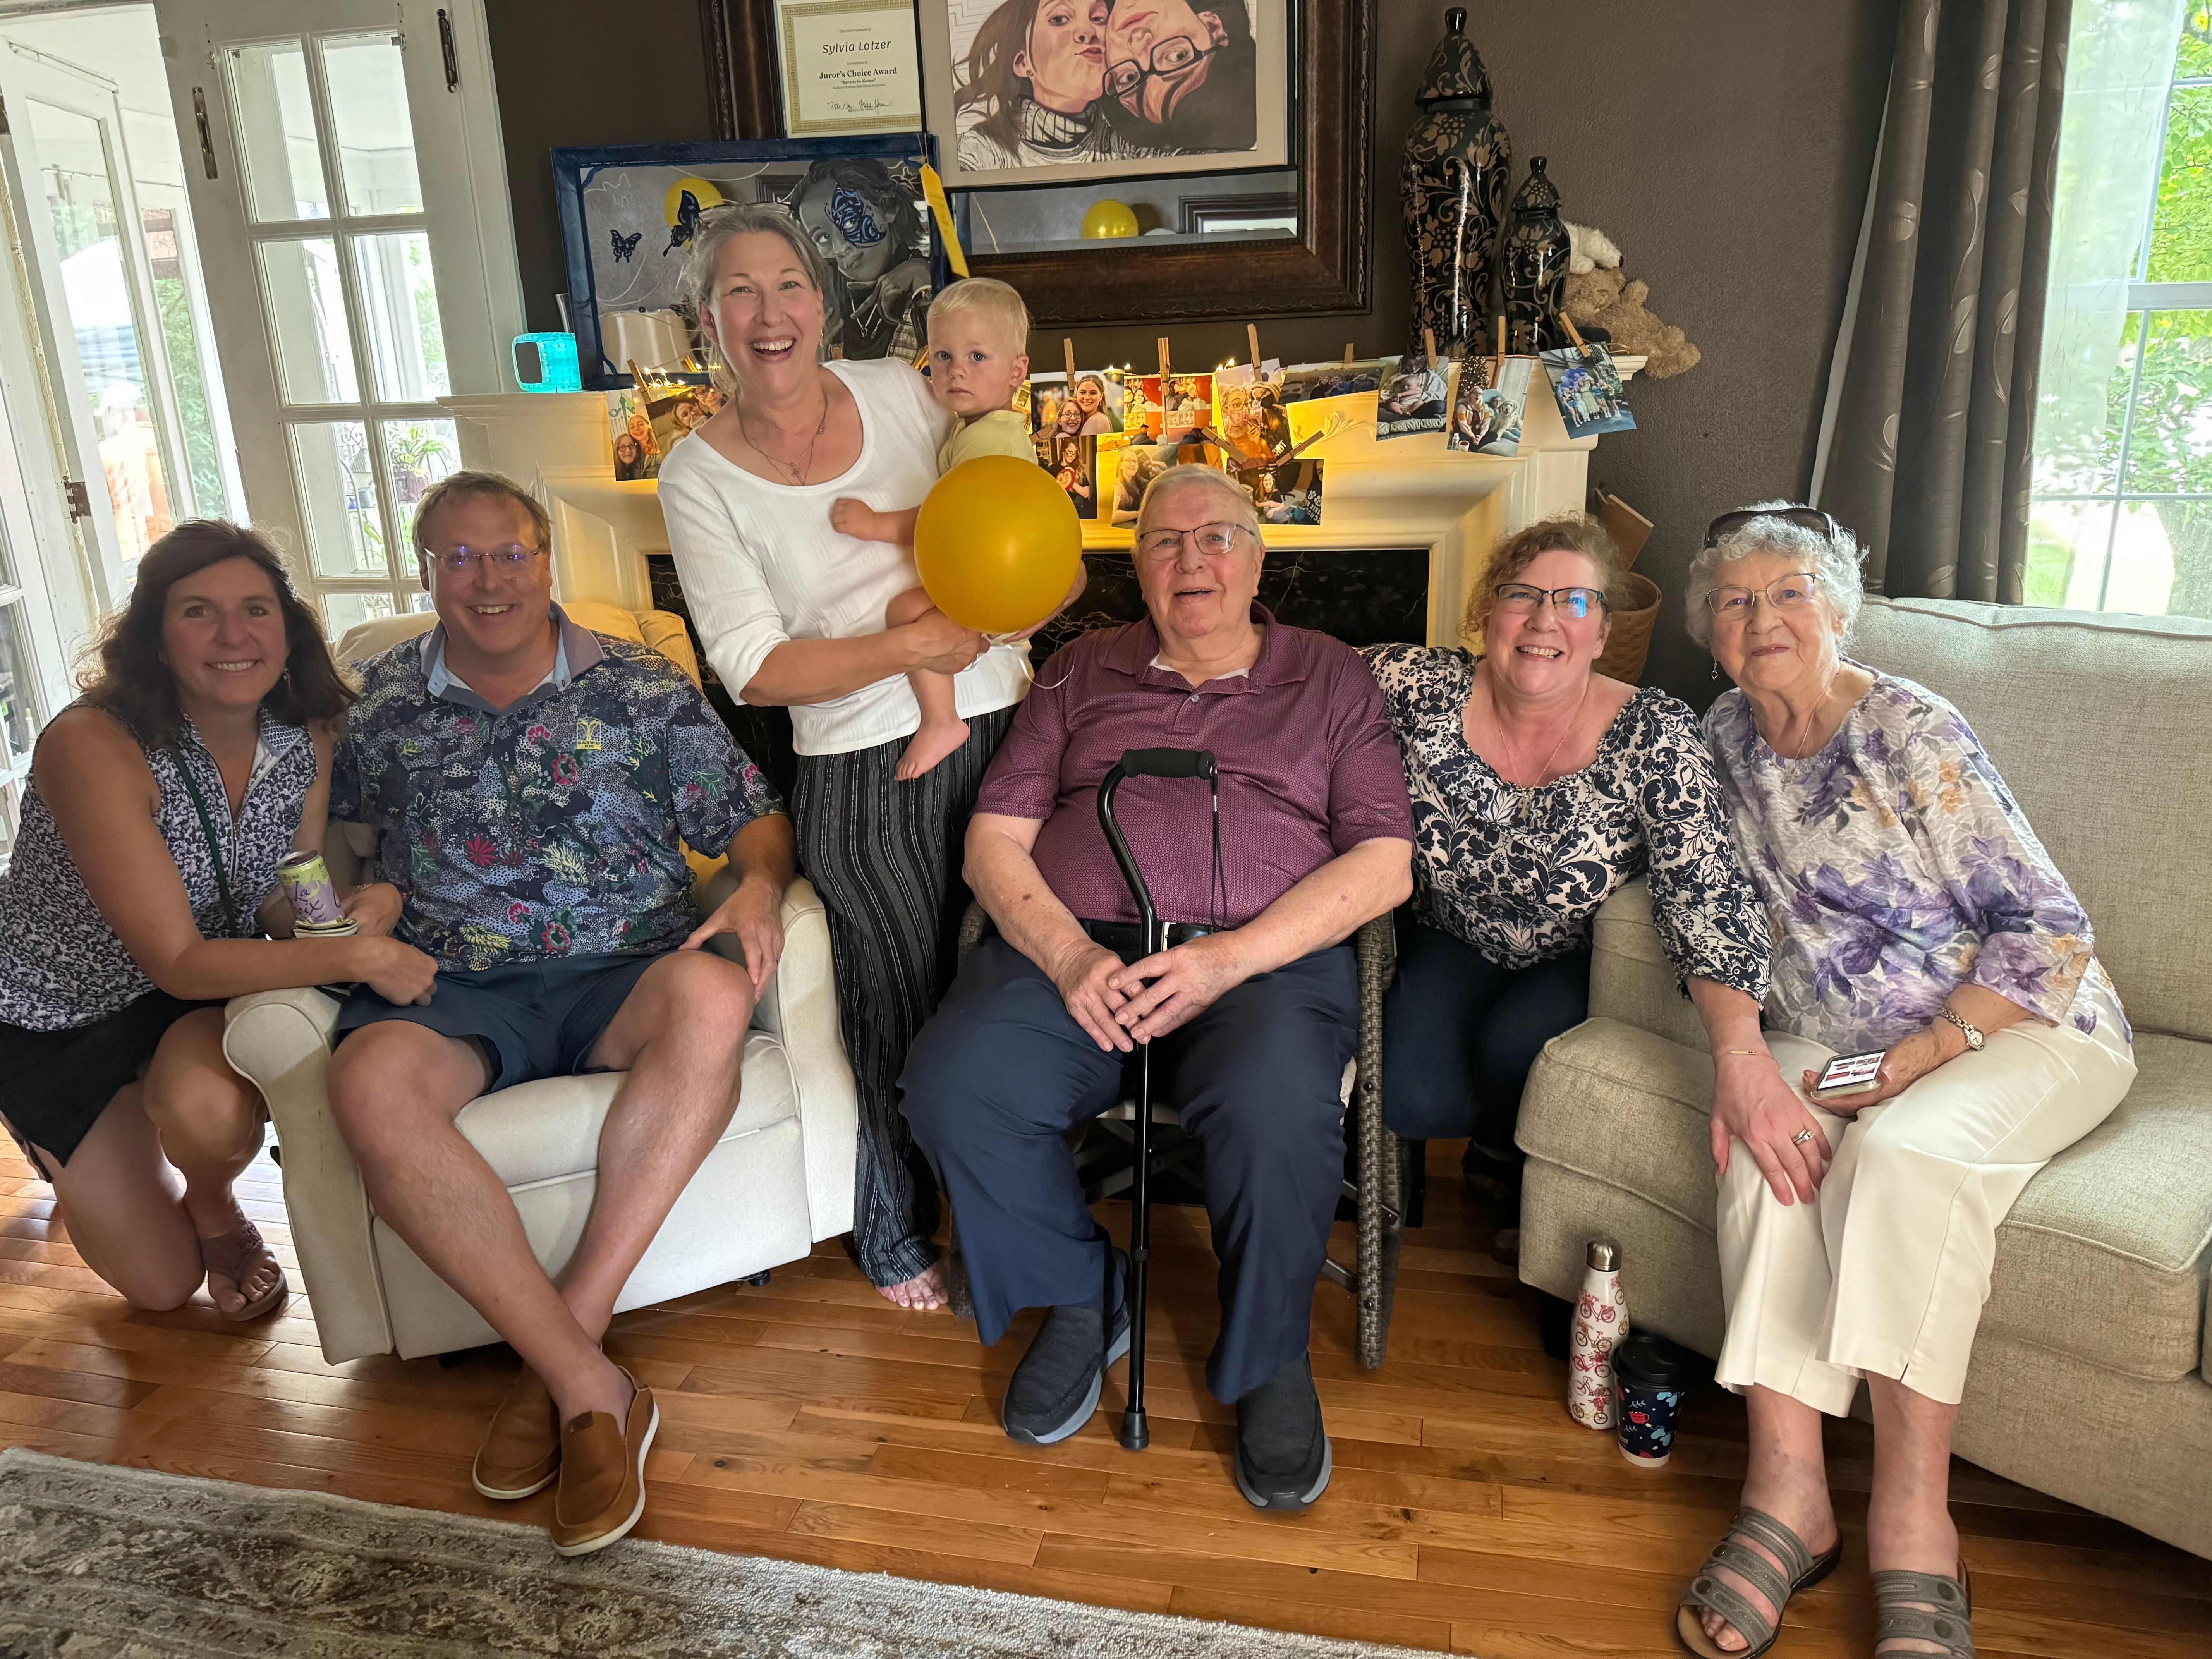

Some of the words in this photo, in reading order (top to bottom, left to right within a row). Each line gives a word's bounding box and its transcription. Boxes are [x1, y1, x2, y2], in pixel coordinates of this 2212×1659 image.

[823, 42, 855, 55] Sylvia
[859, 41, 891, 51] Lotzer
[819, 71, 846, 79] Juror’s
[847, 69, 872, 77] Choice
[873, 67, 897, 76] Award
[293, 880, 311, 902] La
